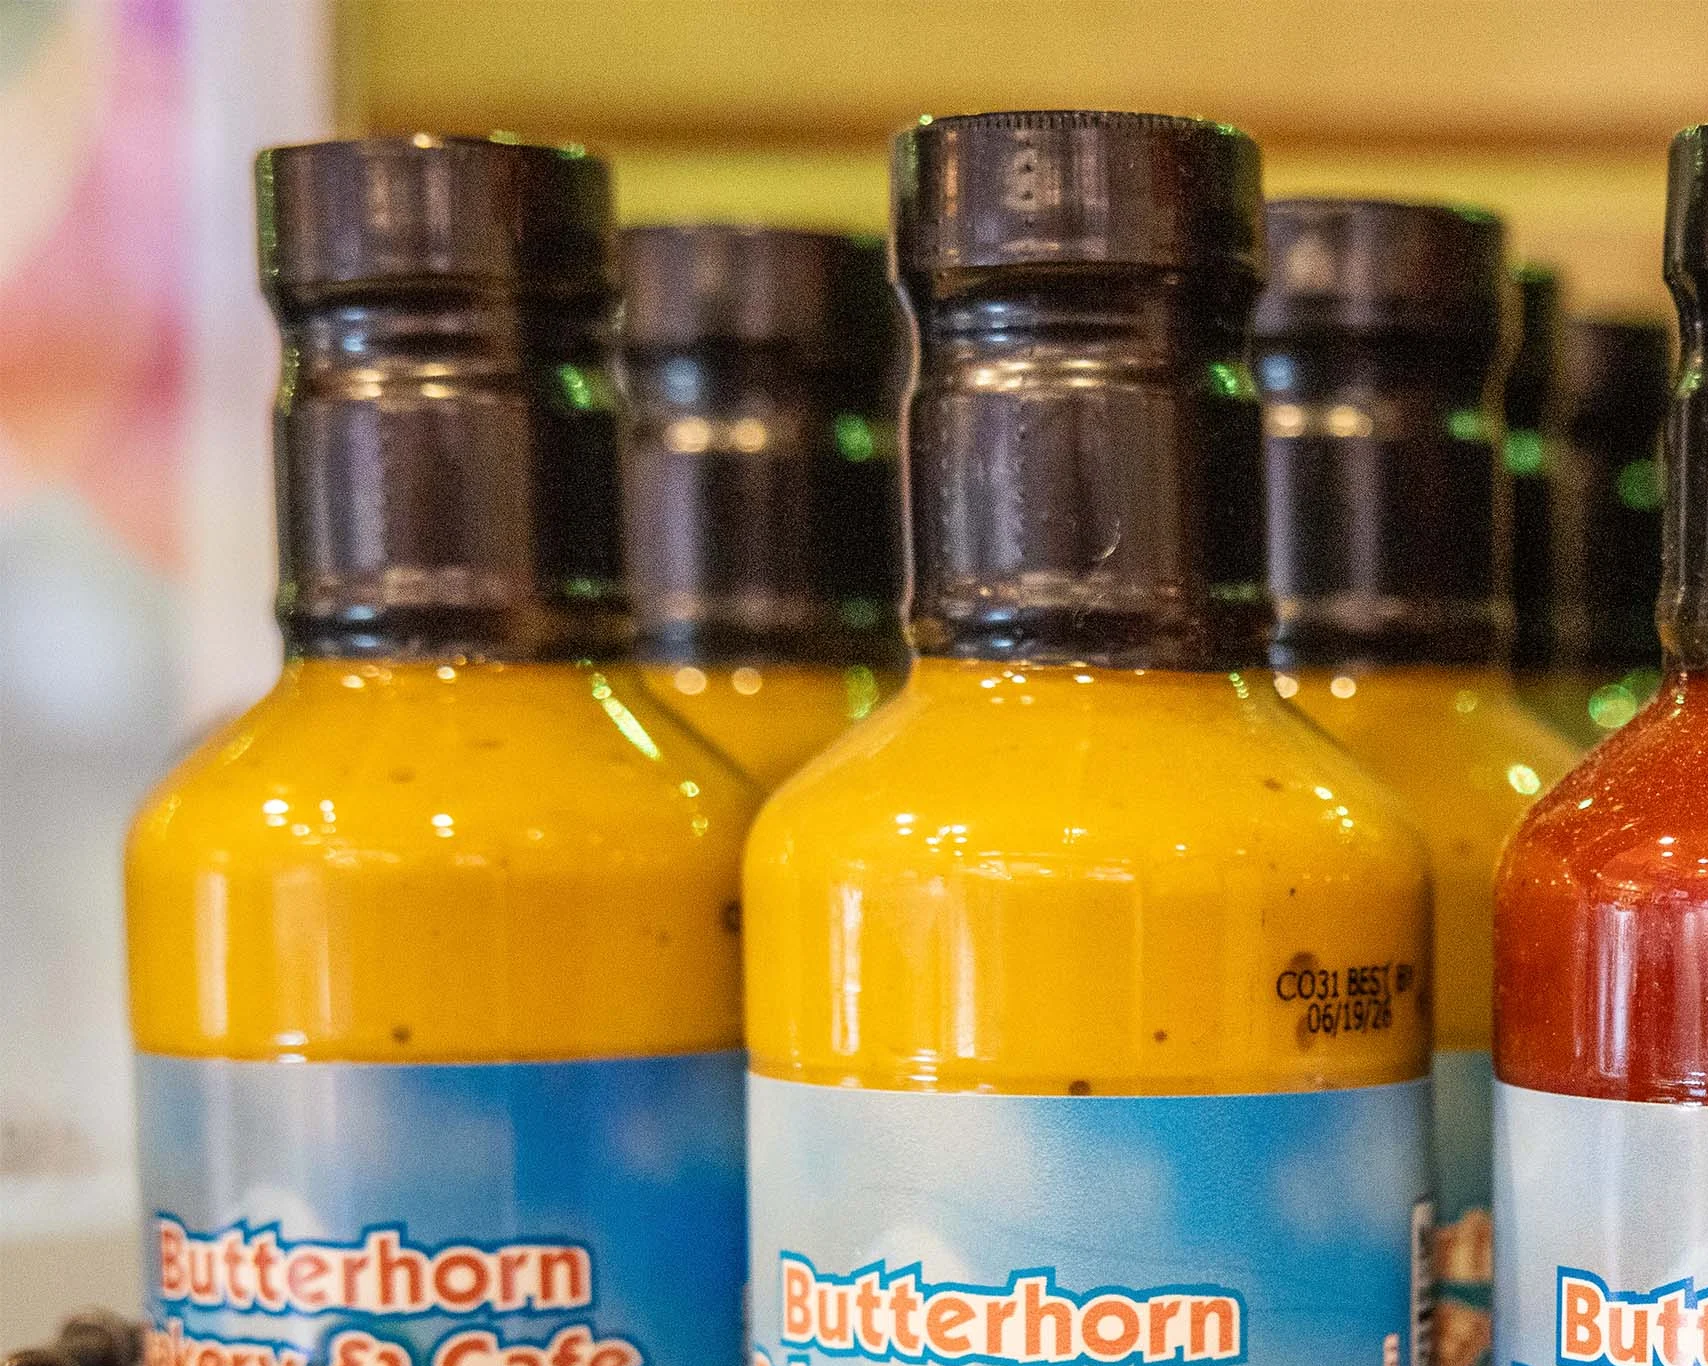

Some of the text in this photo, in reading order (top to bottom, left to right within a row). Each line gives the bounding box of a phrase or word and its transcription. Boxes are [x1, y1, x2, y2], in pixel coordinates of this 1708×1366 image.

[1347, 961, 1392, 997] BEST
[158, 1218, 591, 1313] Butterhorn
[783, 1258, 1240, 1362] Butterhorn
